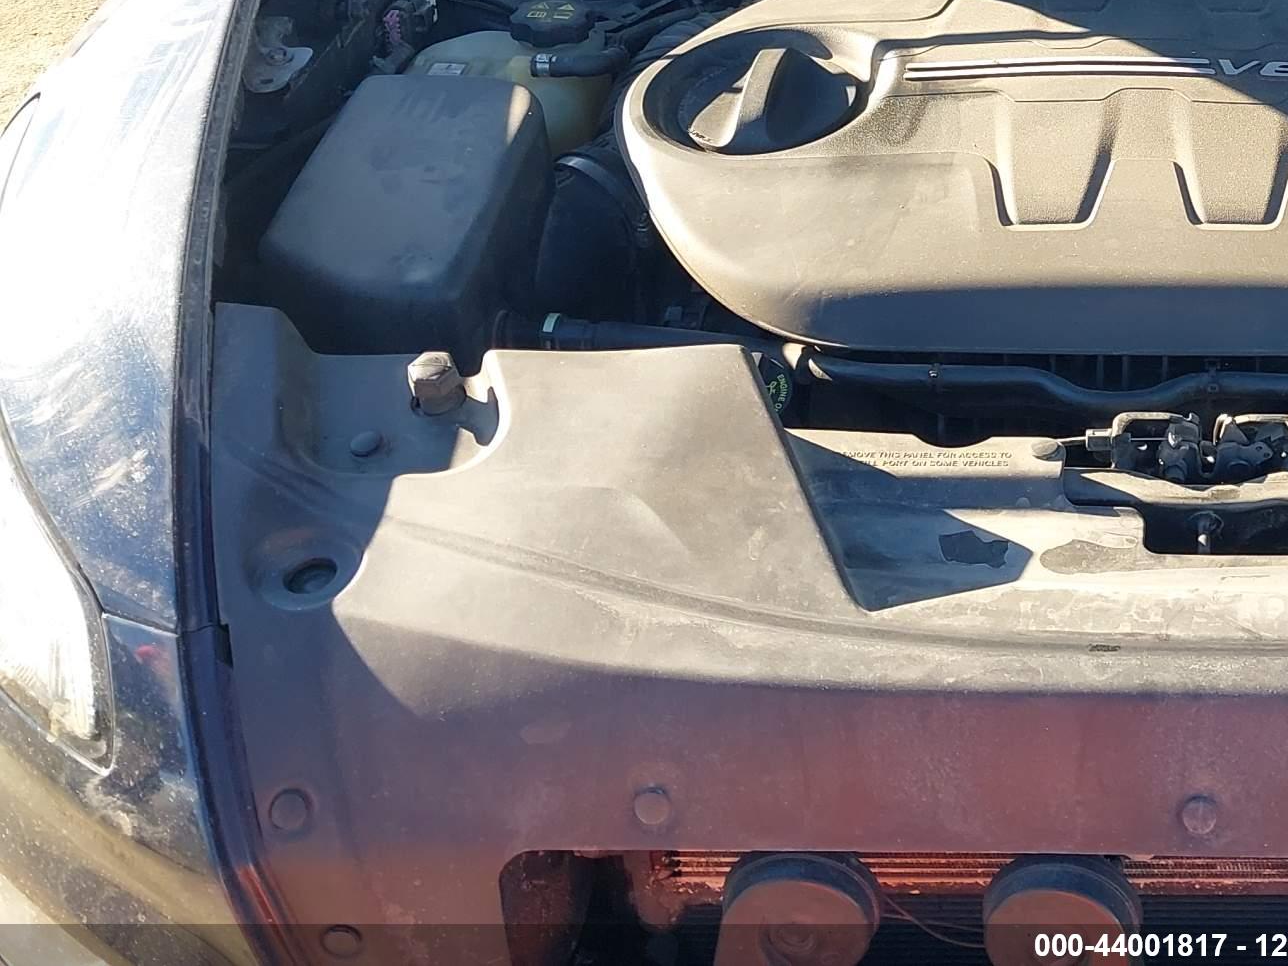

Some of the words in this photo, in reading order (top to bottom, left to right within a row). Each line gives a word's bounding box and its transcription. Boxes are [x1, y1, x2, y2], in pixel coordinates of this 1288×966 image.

[777, 374, 788, 401] ENGINE
[936, 451, 957, 459] FOR
[959, 451, 997, 459] ACCESS
[1000, 451, 1012, 459] TO
